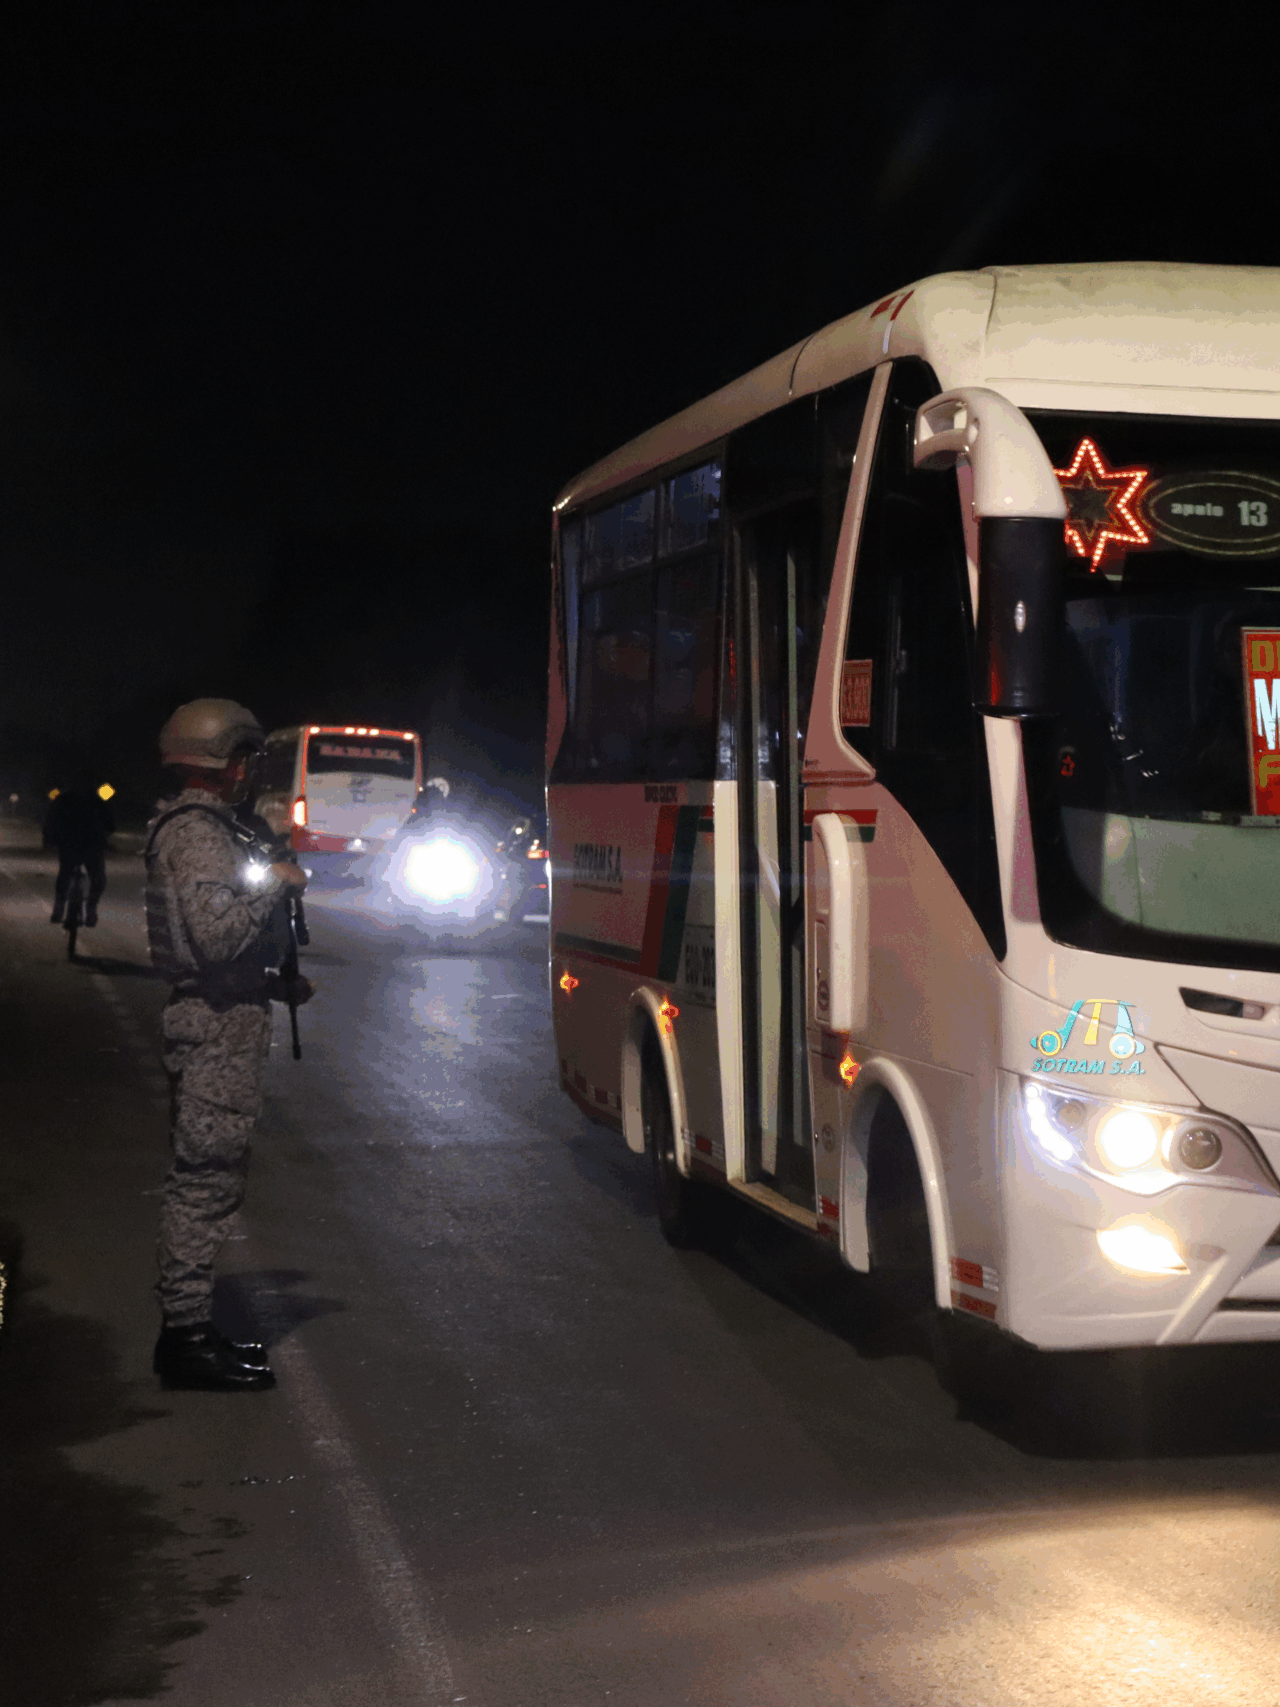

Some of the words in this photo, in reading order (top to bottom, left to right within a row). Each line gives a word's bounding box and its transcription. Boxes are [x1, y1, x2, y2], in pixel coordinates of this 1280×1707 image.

[1237, 500, 1268, 527] 13
[1031, 1057, 1105, 1075] SOTRAM
[1108, 1060, 1146, 1075] S.A.
